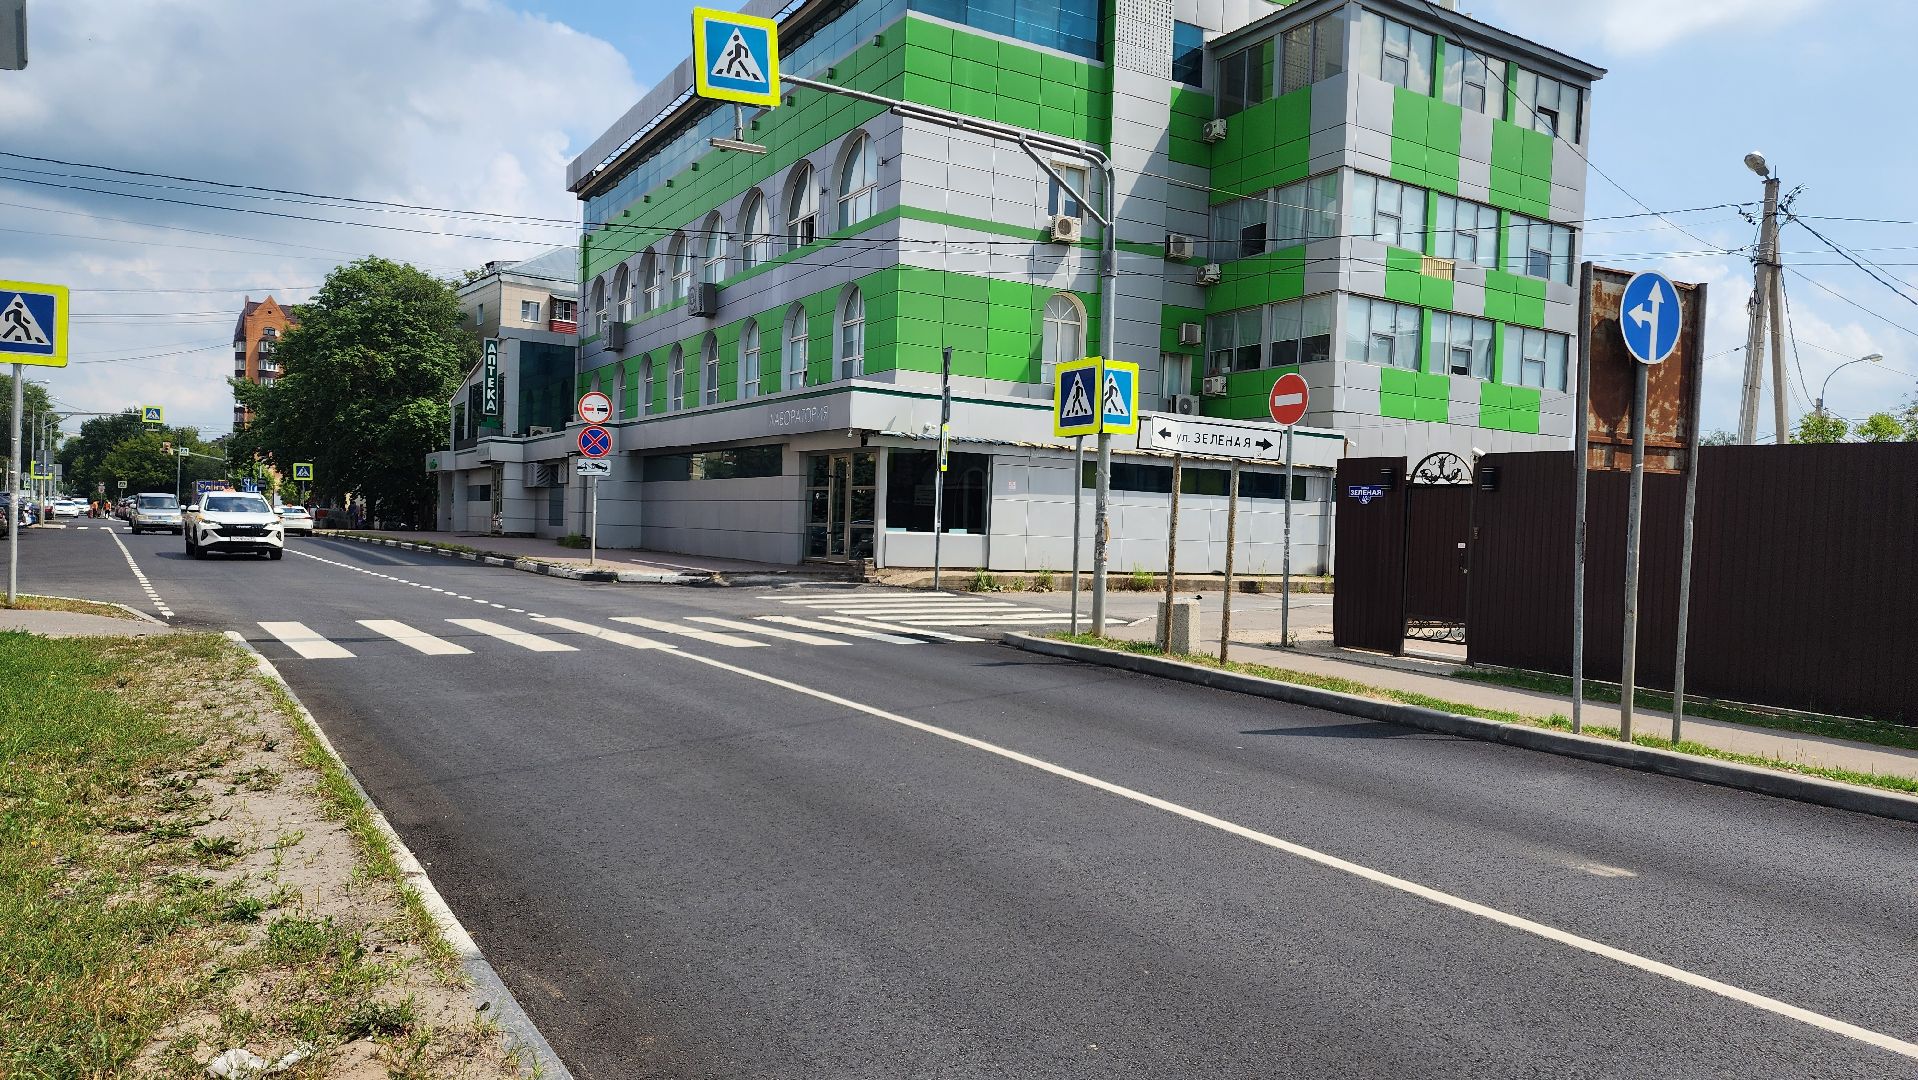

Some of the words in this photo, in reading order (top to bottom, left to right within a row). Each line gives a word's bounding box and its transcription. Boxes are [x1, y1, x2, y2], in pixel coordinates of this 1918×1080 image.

[486, 343, 497, 411] АПТЕКА
[1176, 434, 1191, 445] ул.
[1194, 432, 1251, 448] ЗЕЛЕНАЯ
